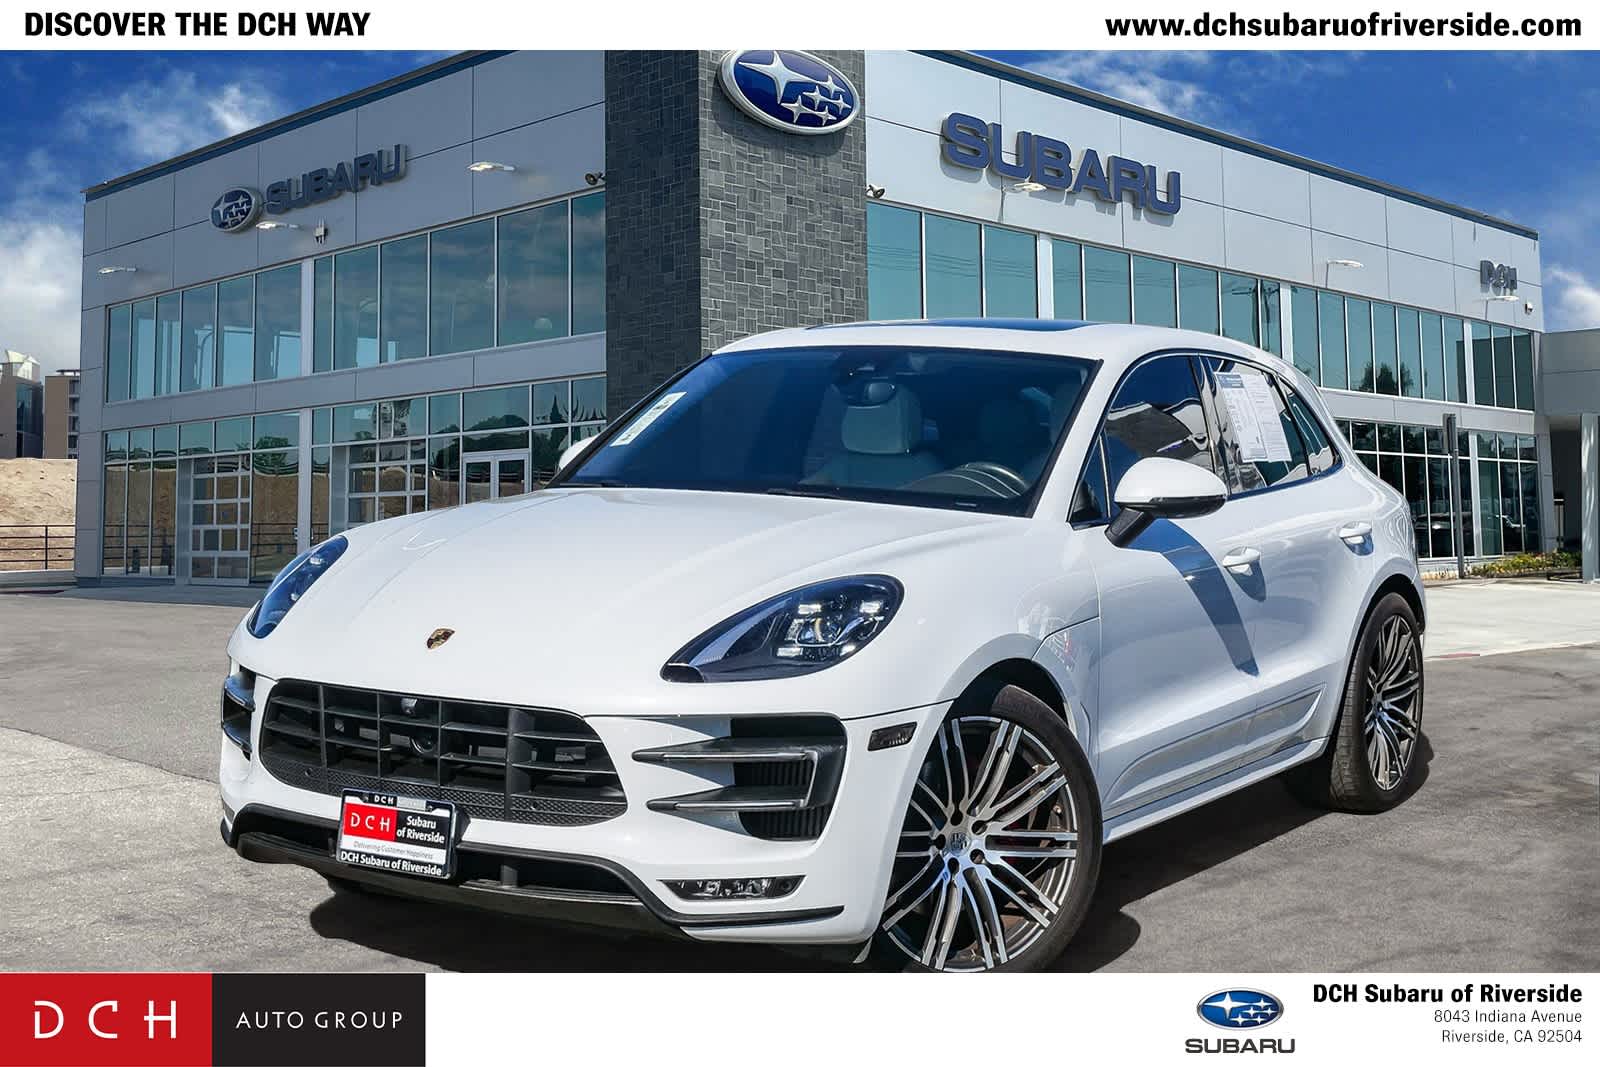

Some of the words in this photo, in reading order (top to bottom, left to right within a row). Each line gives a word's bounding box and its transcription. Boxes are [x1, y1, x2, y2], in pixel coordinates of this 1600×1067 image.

[942, 112, 1180, 214] SUBARU
[266, 144, 407, 214] SUBARU
[374, 795, 394, 804] DCH
[350, 812, 390, 832] DCH
[406, 815, 437, 829] Subaru
[396, 828, 406, 838] of
[406, 829, 445, 844] Riverside
[341, 851, 359, 862] DCH
[360, 855, 390, 868] Subaru
[391, 860, 401, 870] of
[402, 861, 442, 876] Riverside
